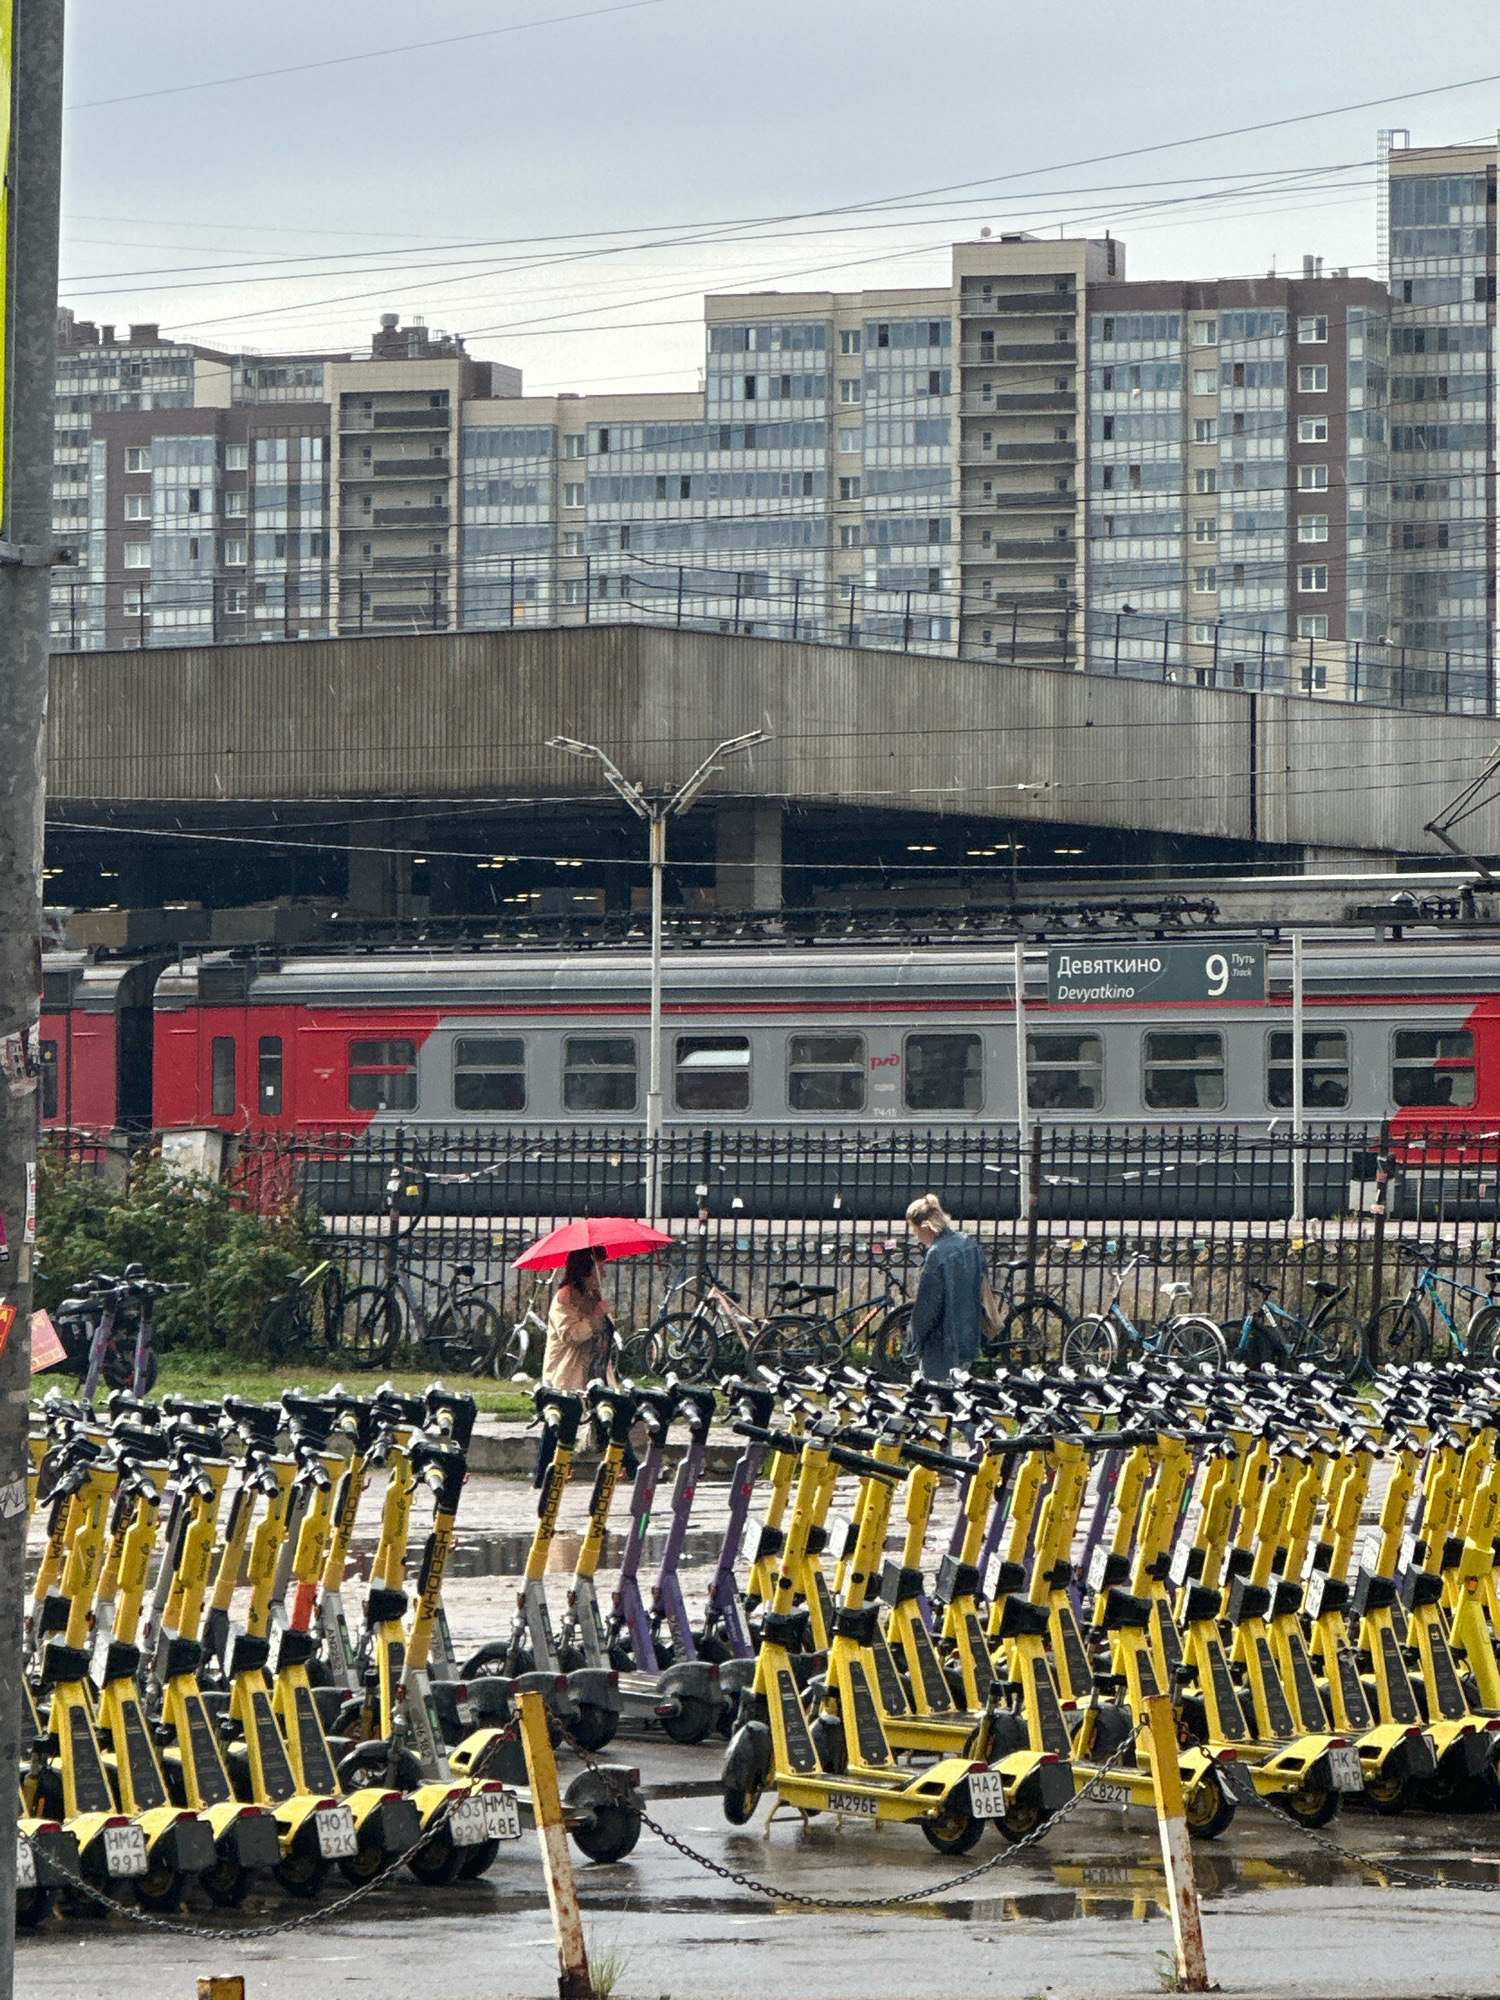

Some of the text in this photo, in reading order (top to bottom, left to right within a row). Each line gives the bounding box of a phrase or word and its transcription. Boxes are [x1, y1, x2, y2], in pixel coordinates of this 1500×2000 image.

[1057, 955, 1161, 978] Девяткино
[1231, 953, 1256, 965] Путь
[1205, 953, 1229, 997] 9
[1231, 968, 1252, 977] Track
[1058, 984, 1135, 1003] Devyatkino
[538, 1462, 567, 1540] WHOOSH
[590, 1460, 618, 1538] WHOOSH
[420, 1530, 451, 1621] WHOOSH
[972, 1775, 1000, 1793] НА2
[485, 1797, 515, 1813] НМ4
[828, 1793, 877, 1814] НА296Е
[975, 1797, 1002, 1814] 96Е
[319, 1813, 351, 1832] НО1
[488, 1818, 517, 1836] 48Е
[107, 1831, 141, 1850] НМ2
[322, 1833, 354, 1855] 32К
[111, 1853, 143, 1874] 99Т
